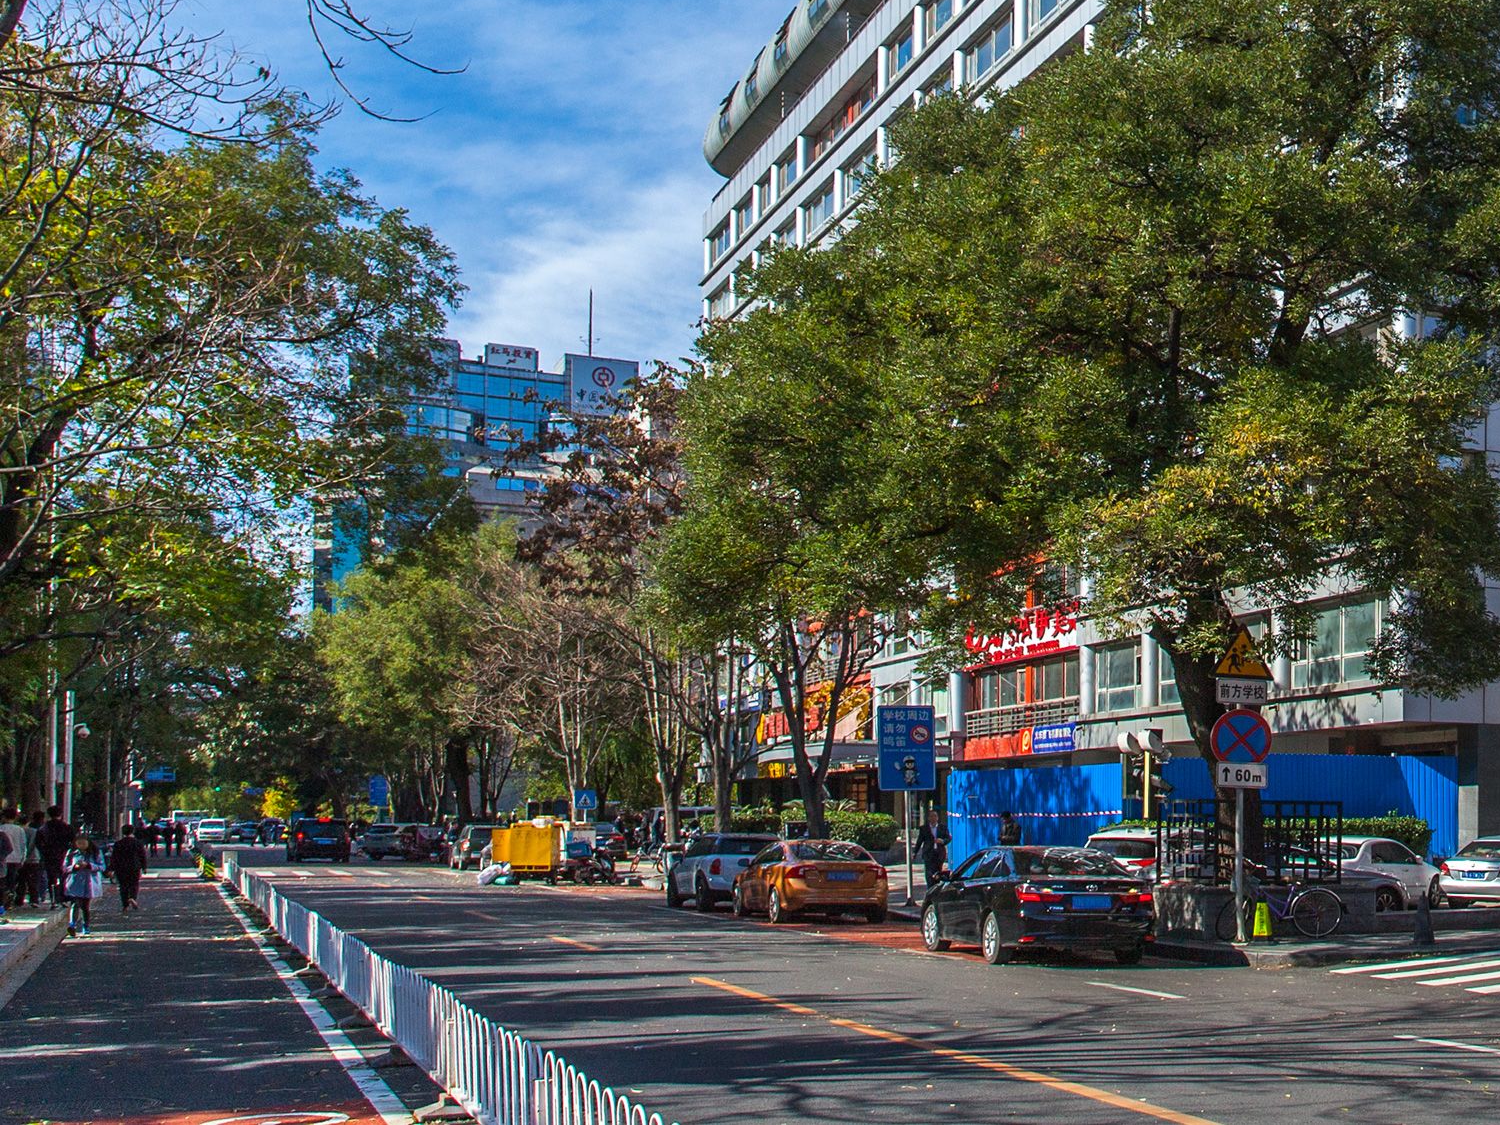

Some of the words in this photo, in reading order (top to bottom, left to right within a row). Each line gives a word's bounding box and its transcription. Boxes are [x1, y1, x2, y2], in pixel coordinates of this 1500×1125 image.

[1220, 683, 1264, 699] 前方学校
[882, 709, 930, 722] 学校周边
[883, 723, 907, 735] 请勿
[1235, 769, 1262, 783] 60m
